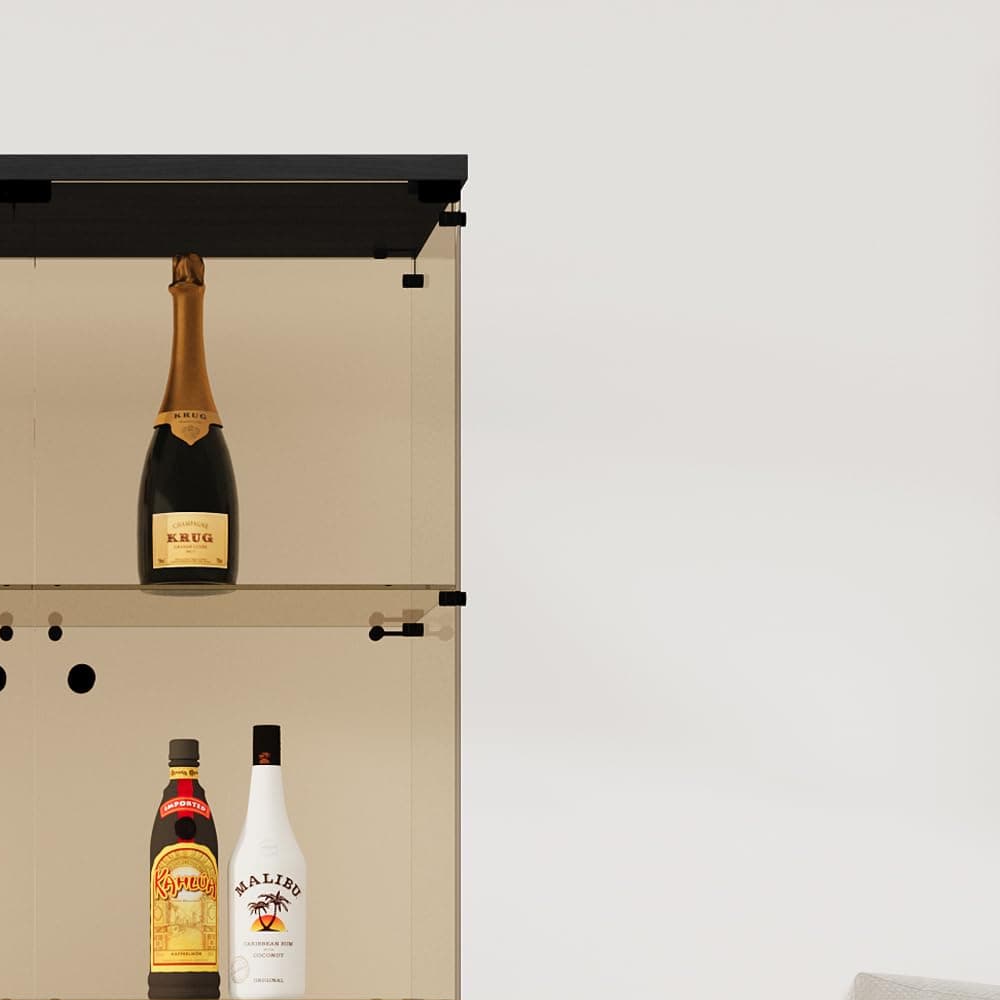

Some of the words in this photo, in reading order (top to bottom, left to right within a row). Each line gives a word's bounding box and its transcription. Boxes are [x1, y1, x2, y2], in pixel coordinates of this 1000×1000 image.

[174, 412, 207, 420] KRUG
[167, 533, 213, 543] KRUG
[163, 800, 207, 812] IMPORTED
[235, 873, 302, 899] MALIBU
